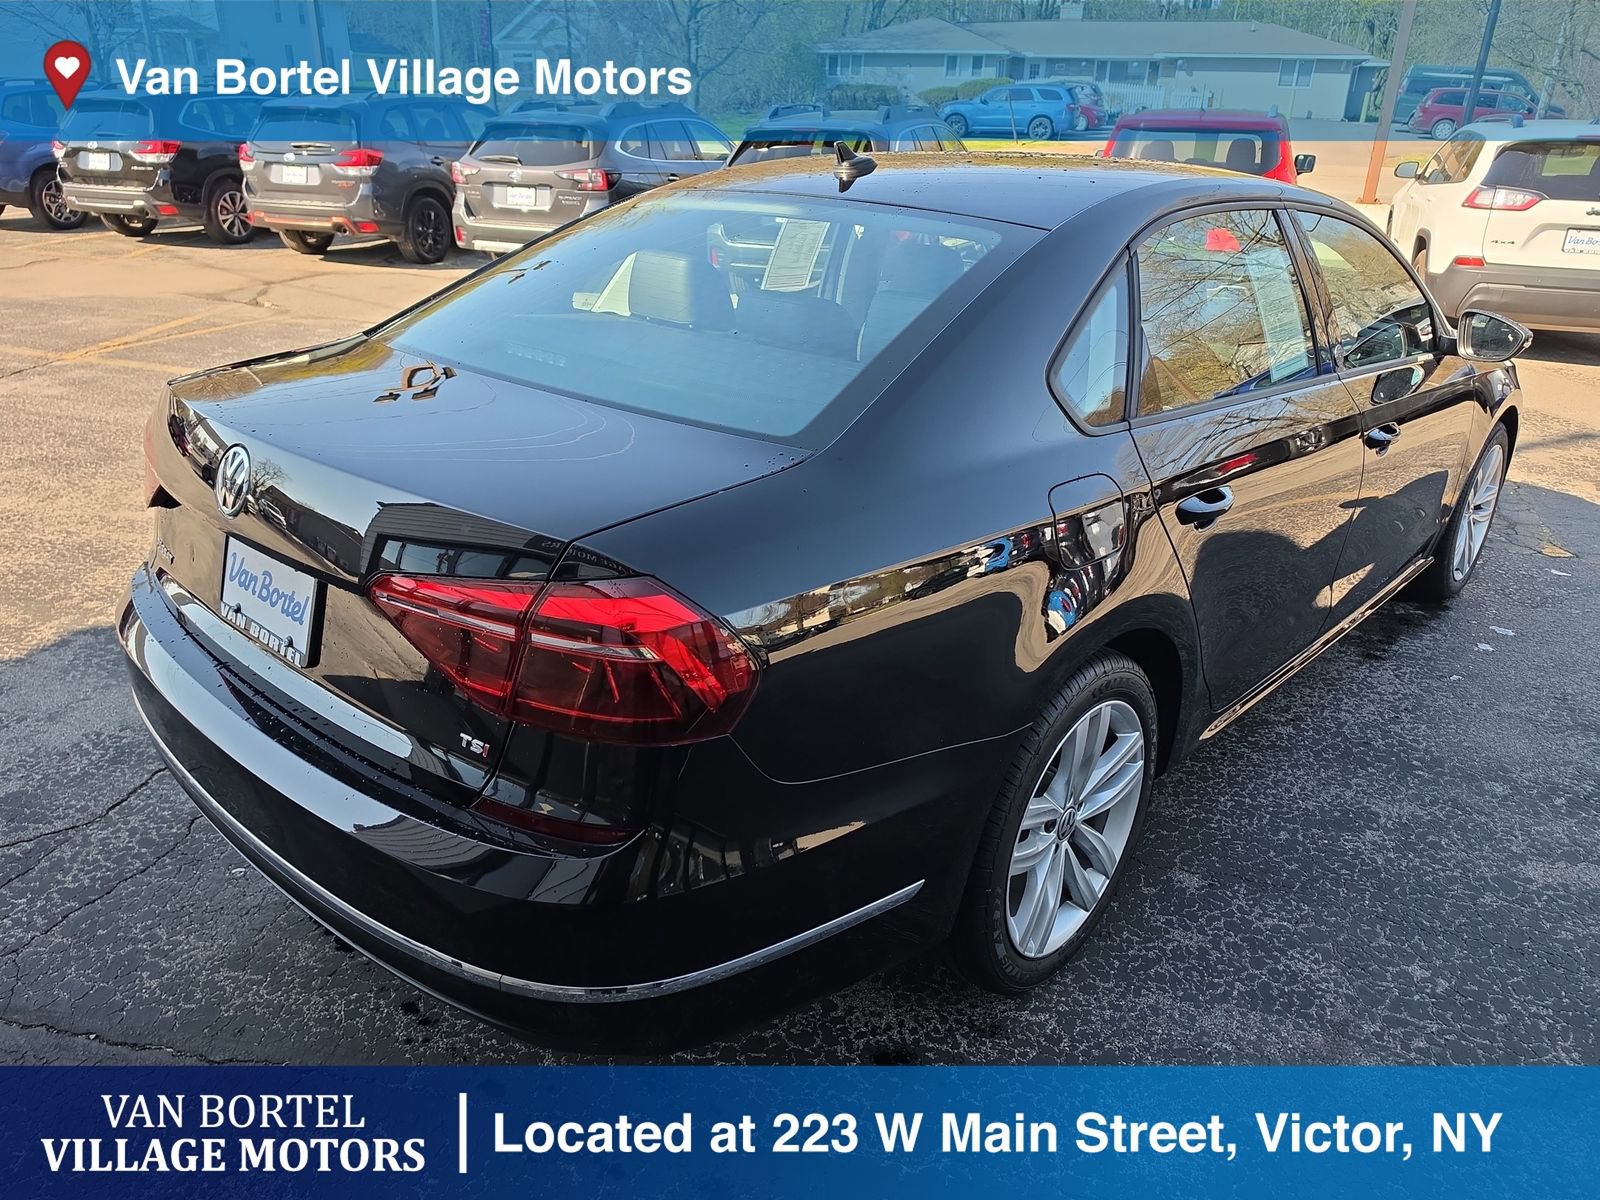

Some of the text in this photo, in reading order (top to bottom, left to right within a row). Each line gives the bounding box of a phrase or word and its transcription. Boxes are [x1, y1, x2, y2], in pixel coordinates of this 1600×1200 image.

[229, 551, 259, 596] Van
[257, 570, 310, 626] Bortel
[220, 600, 302, 668] VAN BORTEL
